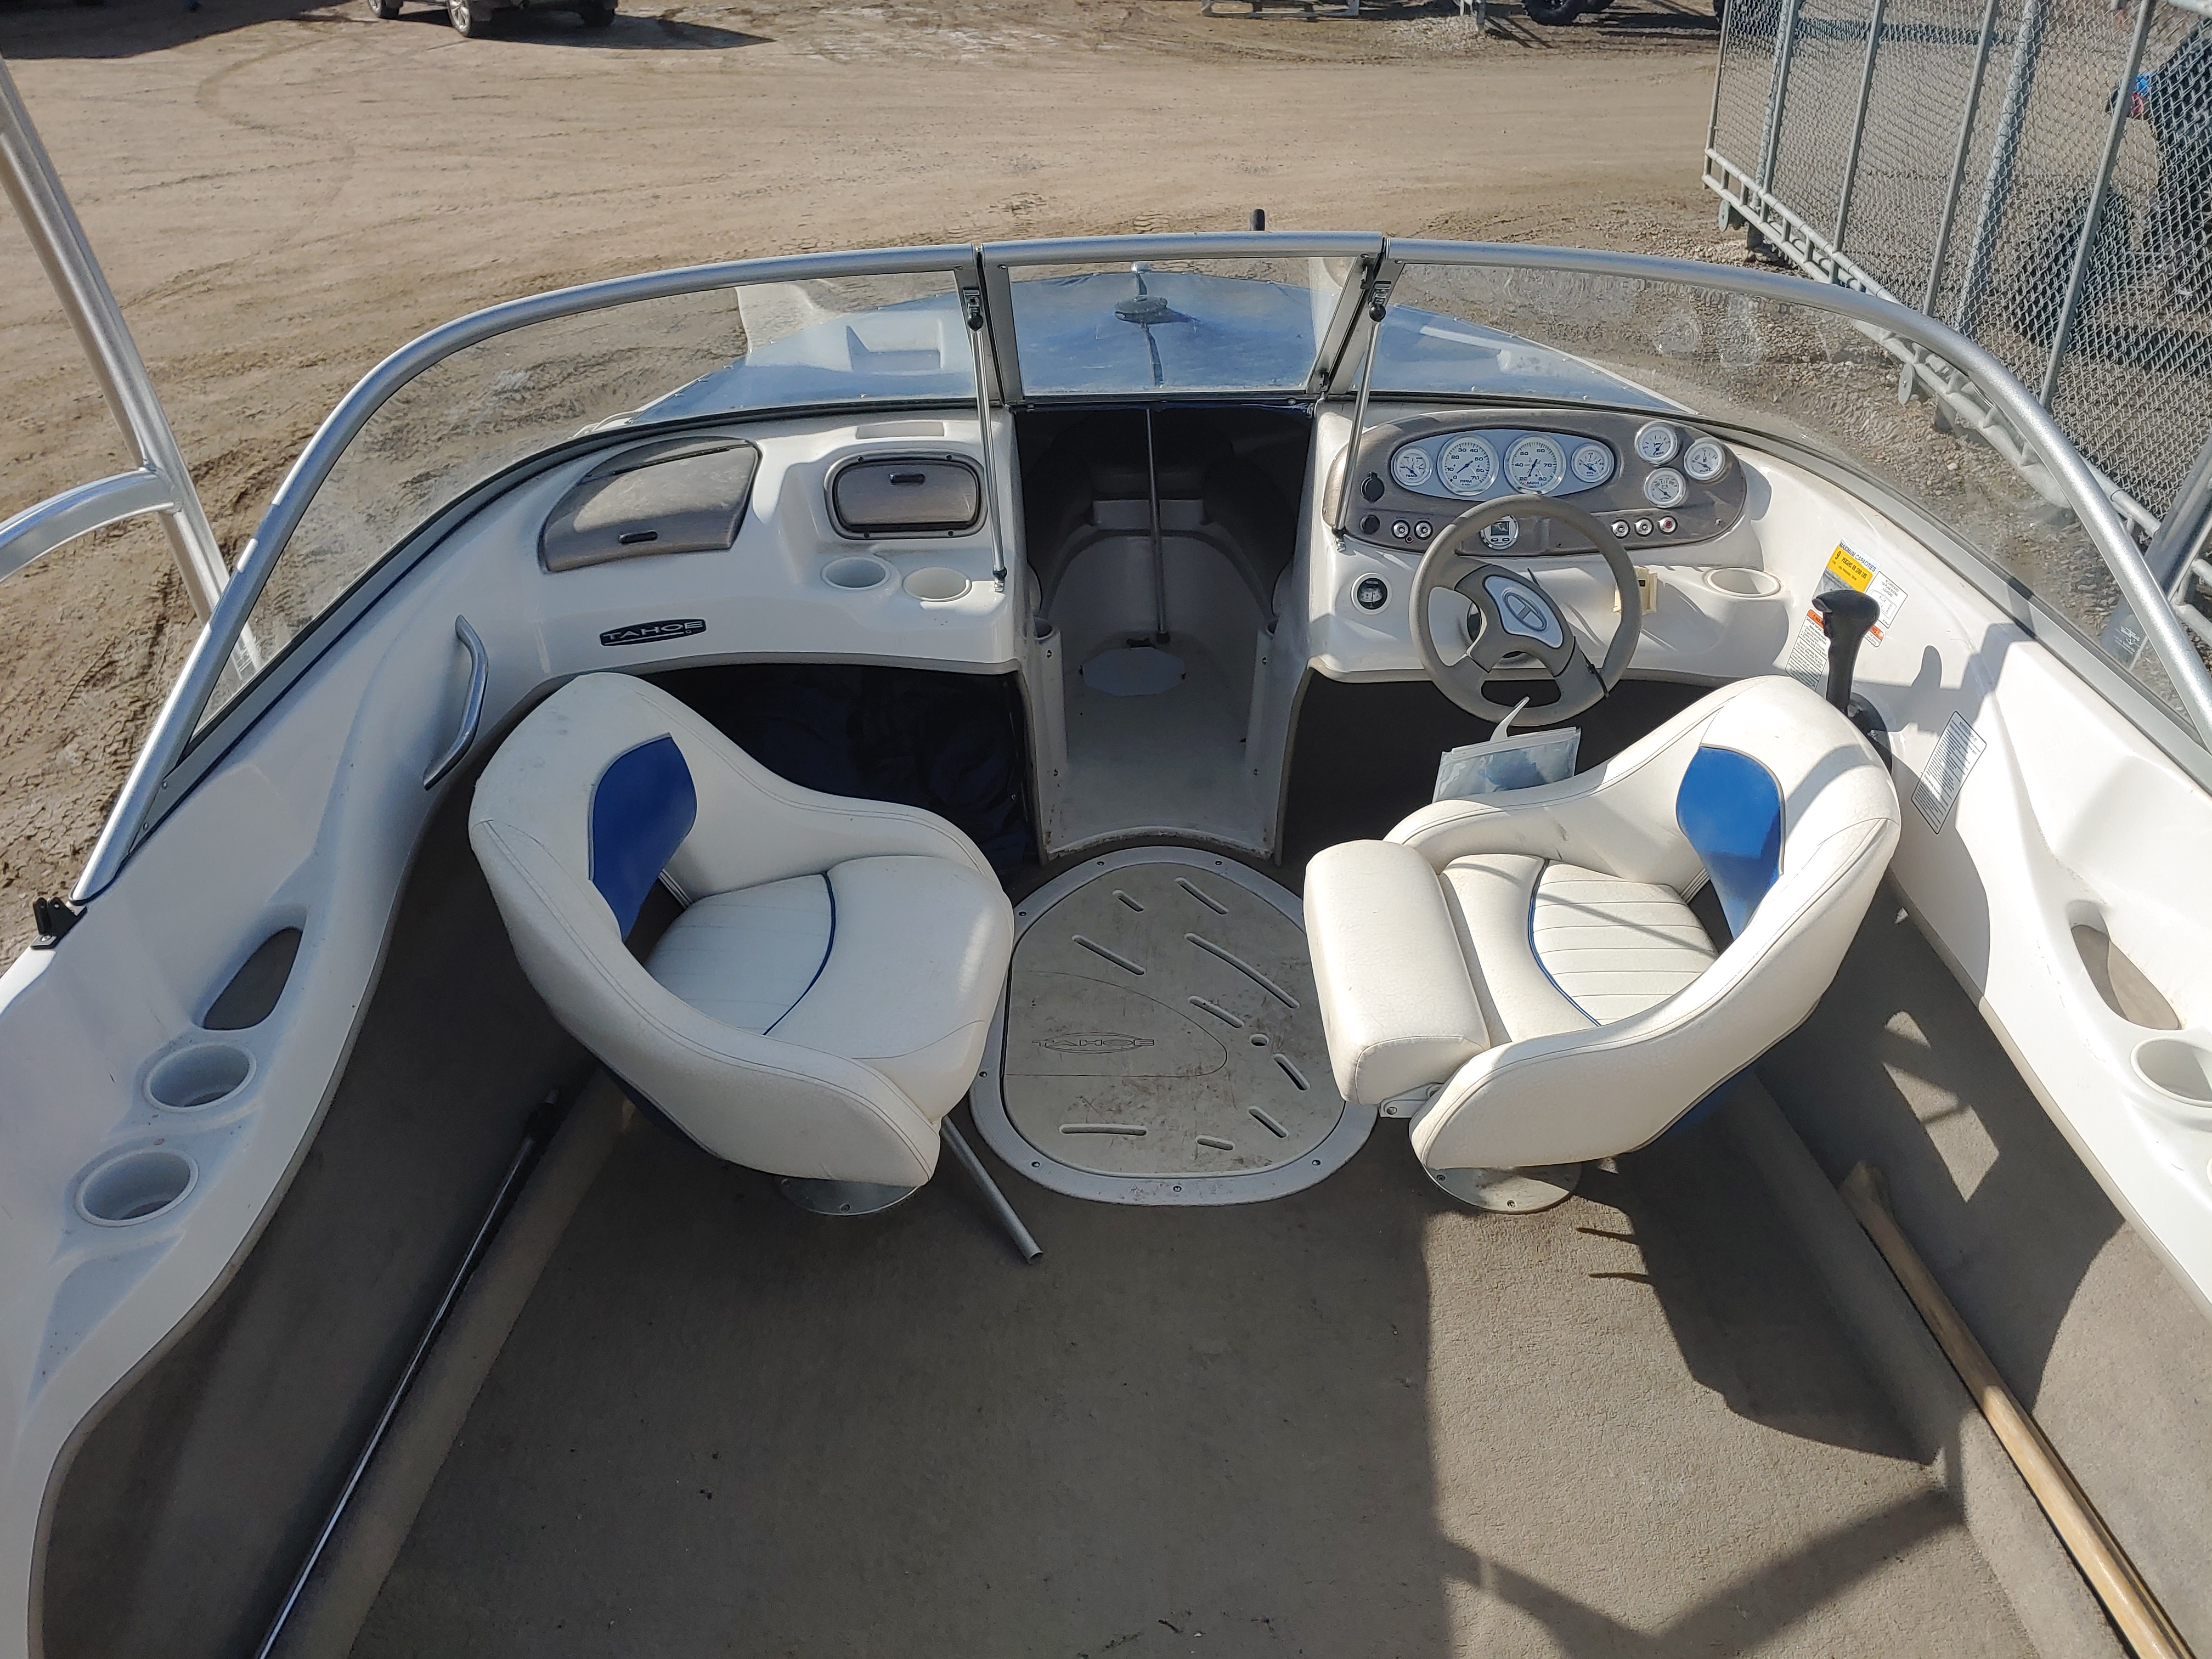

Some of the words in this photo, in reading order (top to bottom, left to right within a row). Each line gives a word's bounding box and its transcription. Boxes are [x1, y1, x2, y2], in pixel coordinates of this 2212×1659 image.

[1835, 551, 1841, 560] 9
[1839, 542, 1857, 557] MAXIMUM
[1855, 555, 1876, 572] CAPACITIES
[603, 620, 703, 640] TAHOE
[1031, 1039, 1154, 1047] TAHOE
